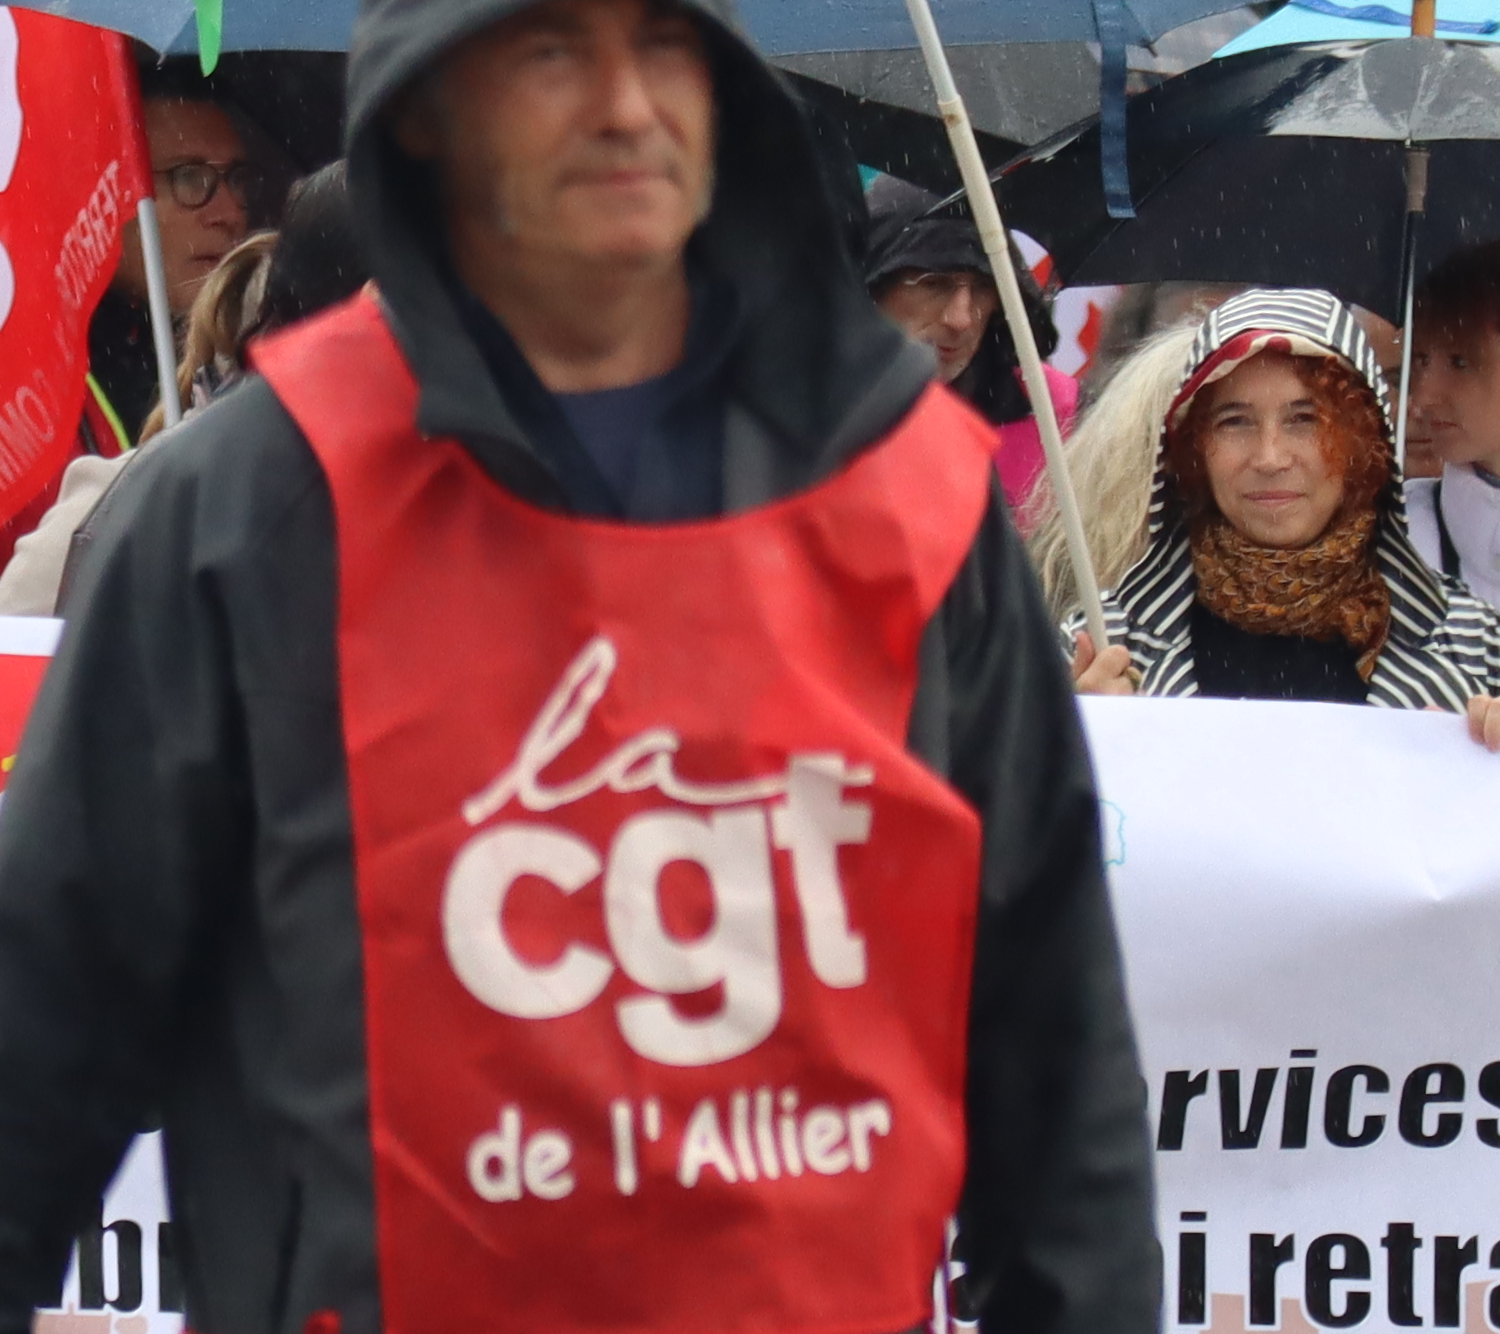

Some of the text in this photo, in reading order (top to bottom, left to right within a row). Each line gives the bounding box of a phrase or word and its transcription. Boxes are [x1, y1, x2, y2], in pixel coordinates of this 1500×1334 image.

[462, 635, 874, 825] la
[441, 752, 871, 1067] cgt
[466, 1106, 572, 1203] de
